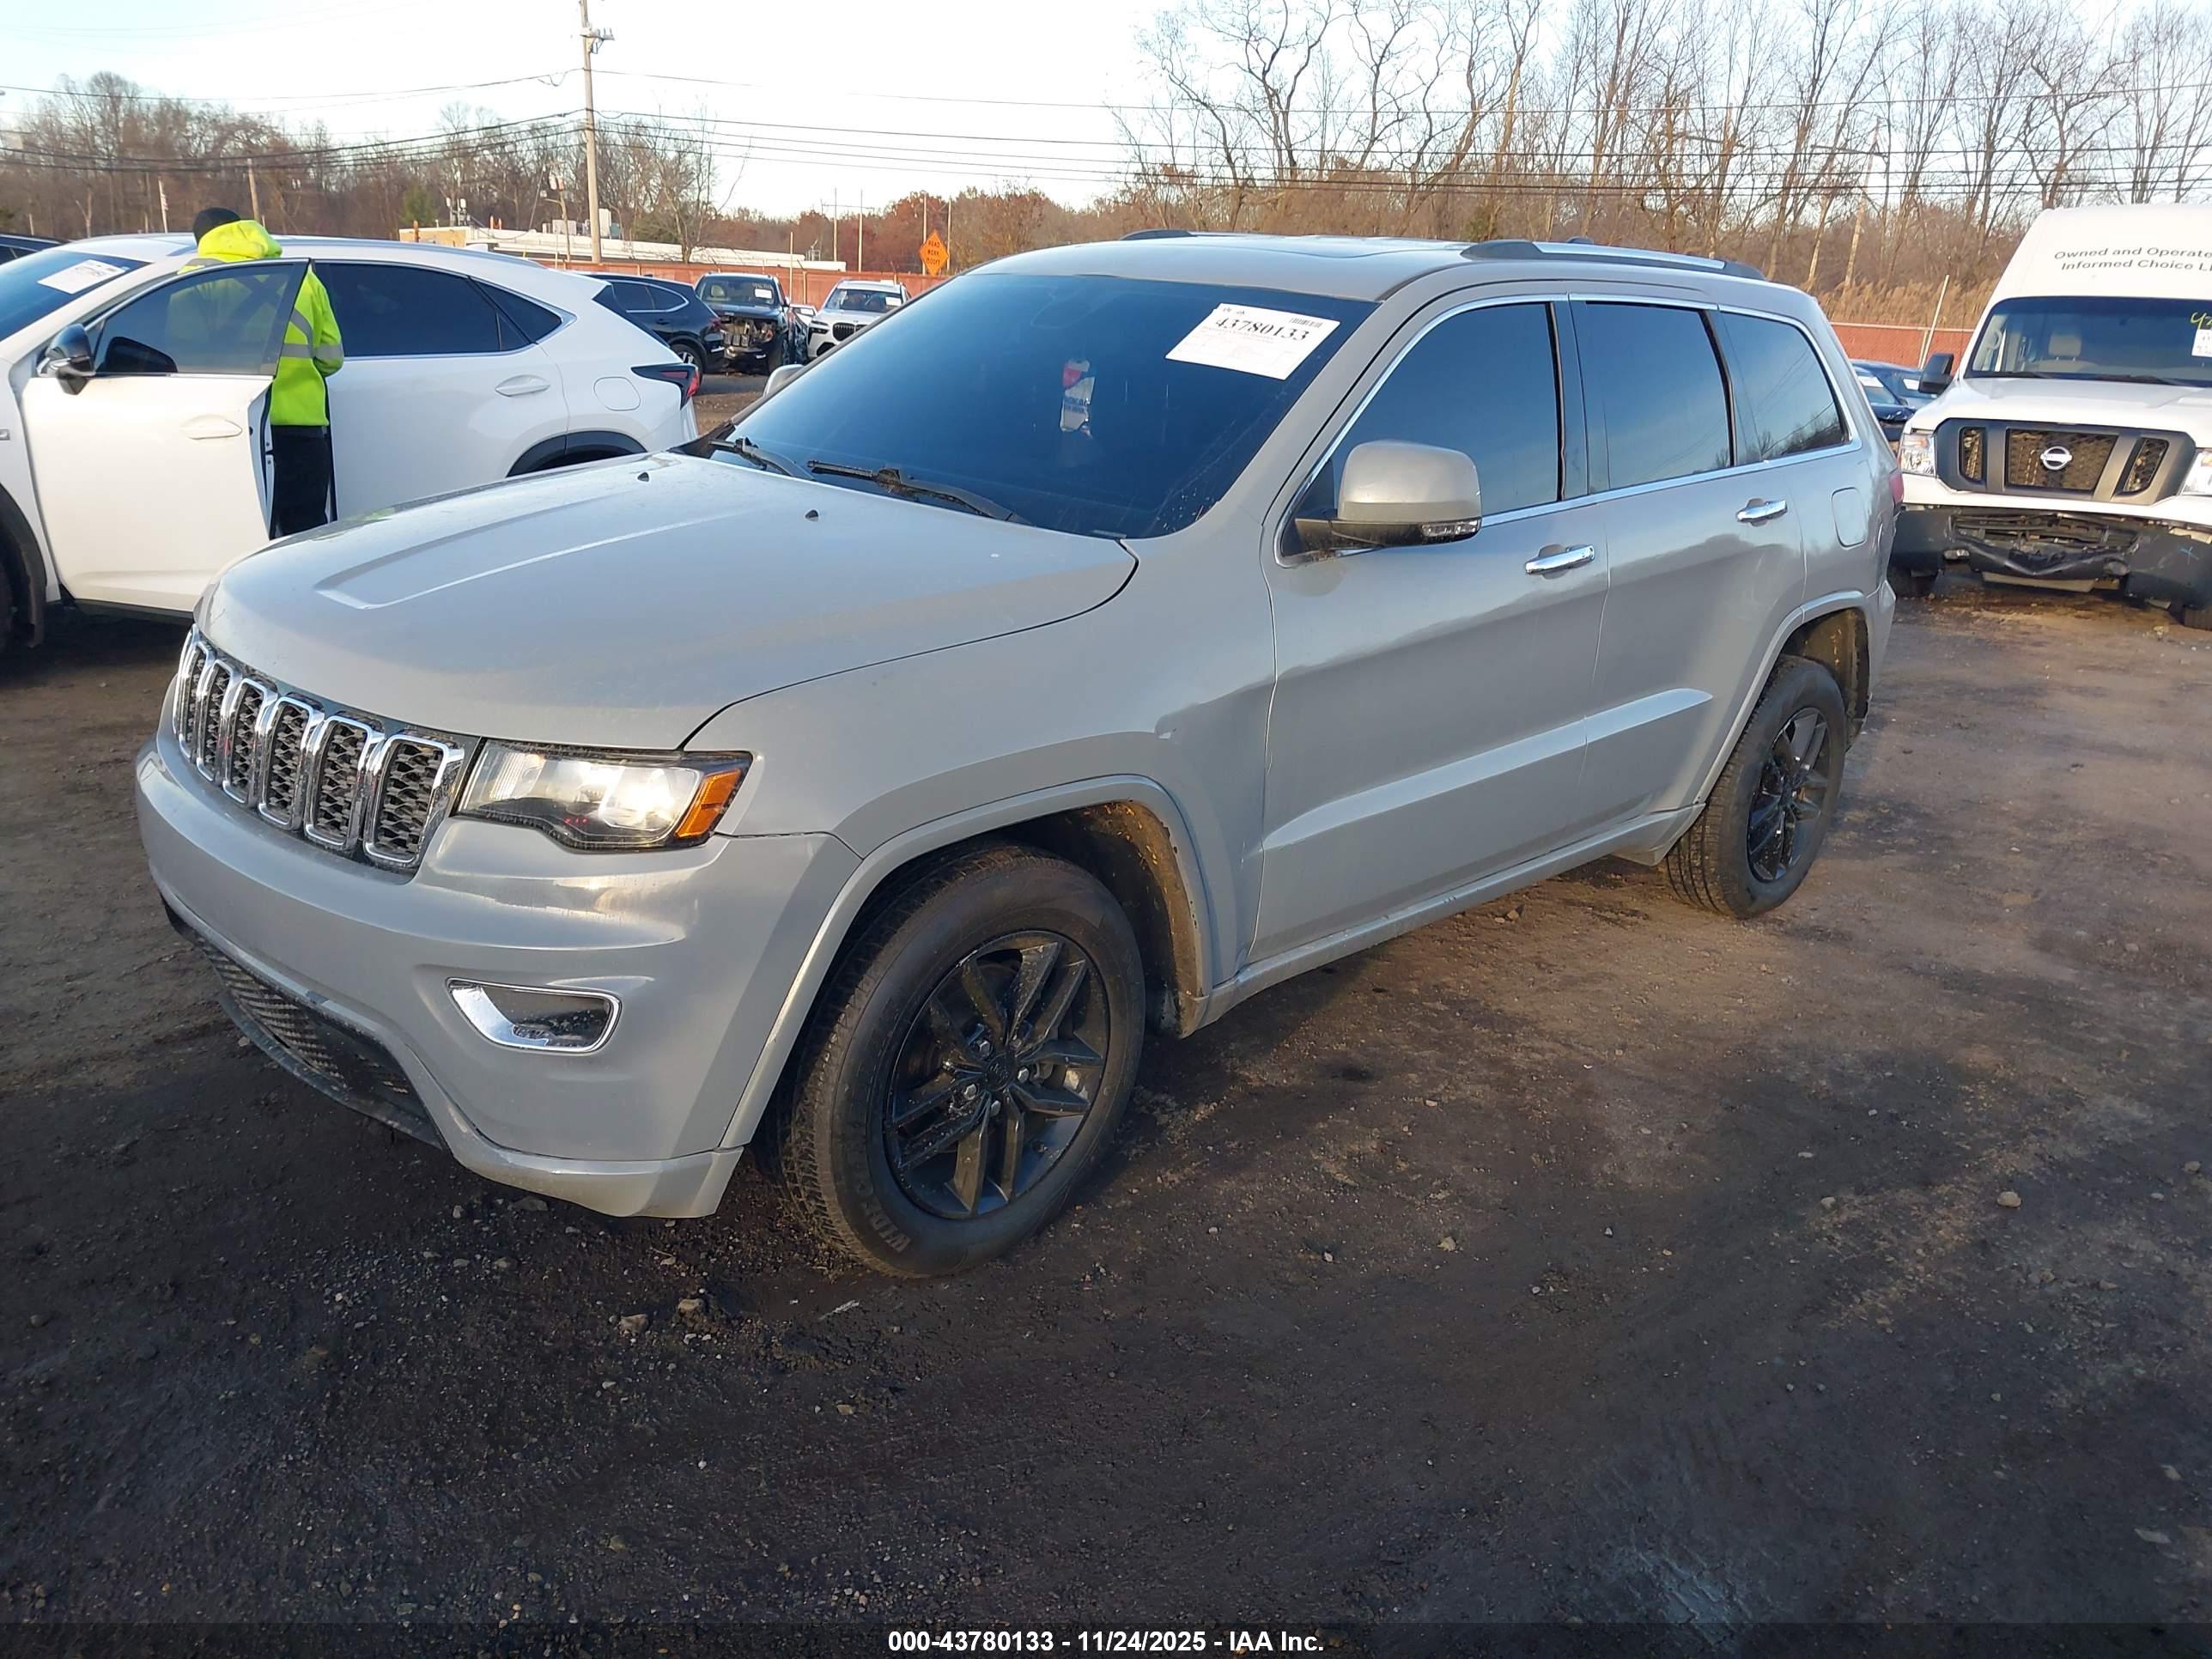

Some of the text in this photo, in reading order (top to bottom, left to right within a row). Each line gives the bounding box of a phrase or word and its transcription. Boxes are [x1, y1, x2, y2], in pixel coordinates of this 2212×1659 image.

[2053, 247, 2108, 259] Owned
[2112, 246, 2142, 255] and
[2061, 258, 2133, 270] Informed
[2137, 259, 2193, 270] Choice
[1216, 317, 1310, 341] 43780133
